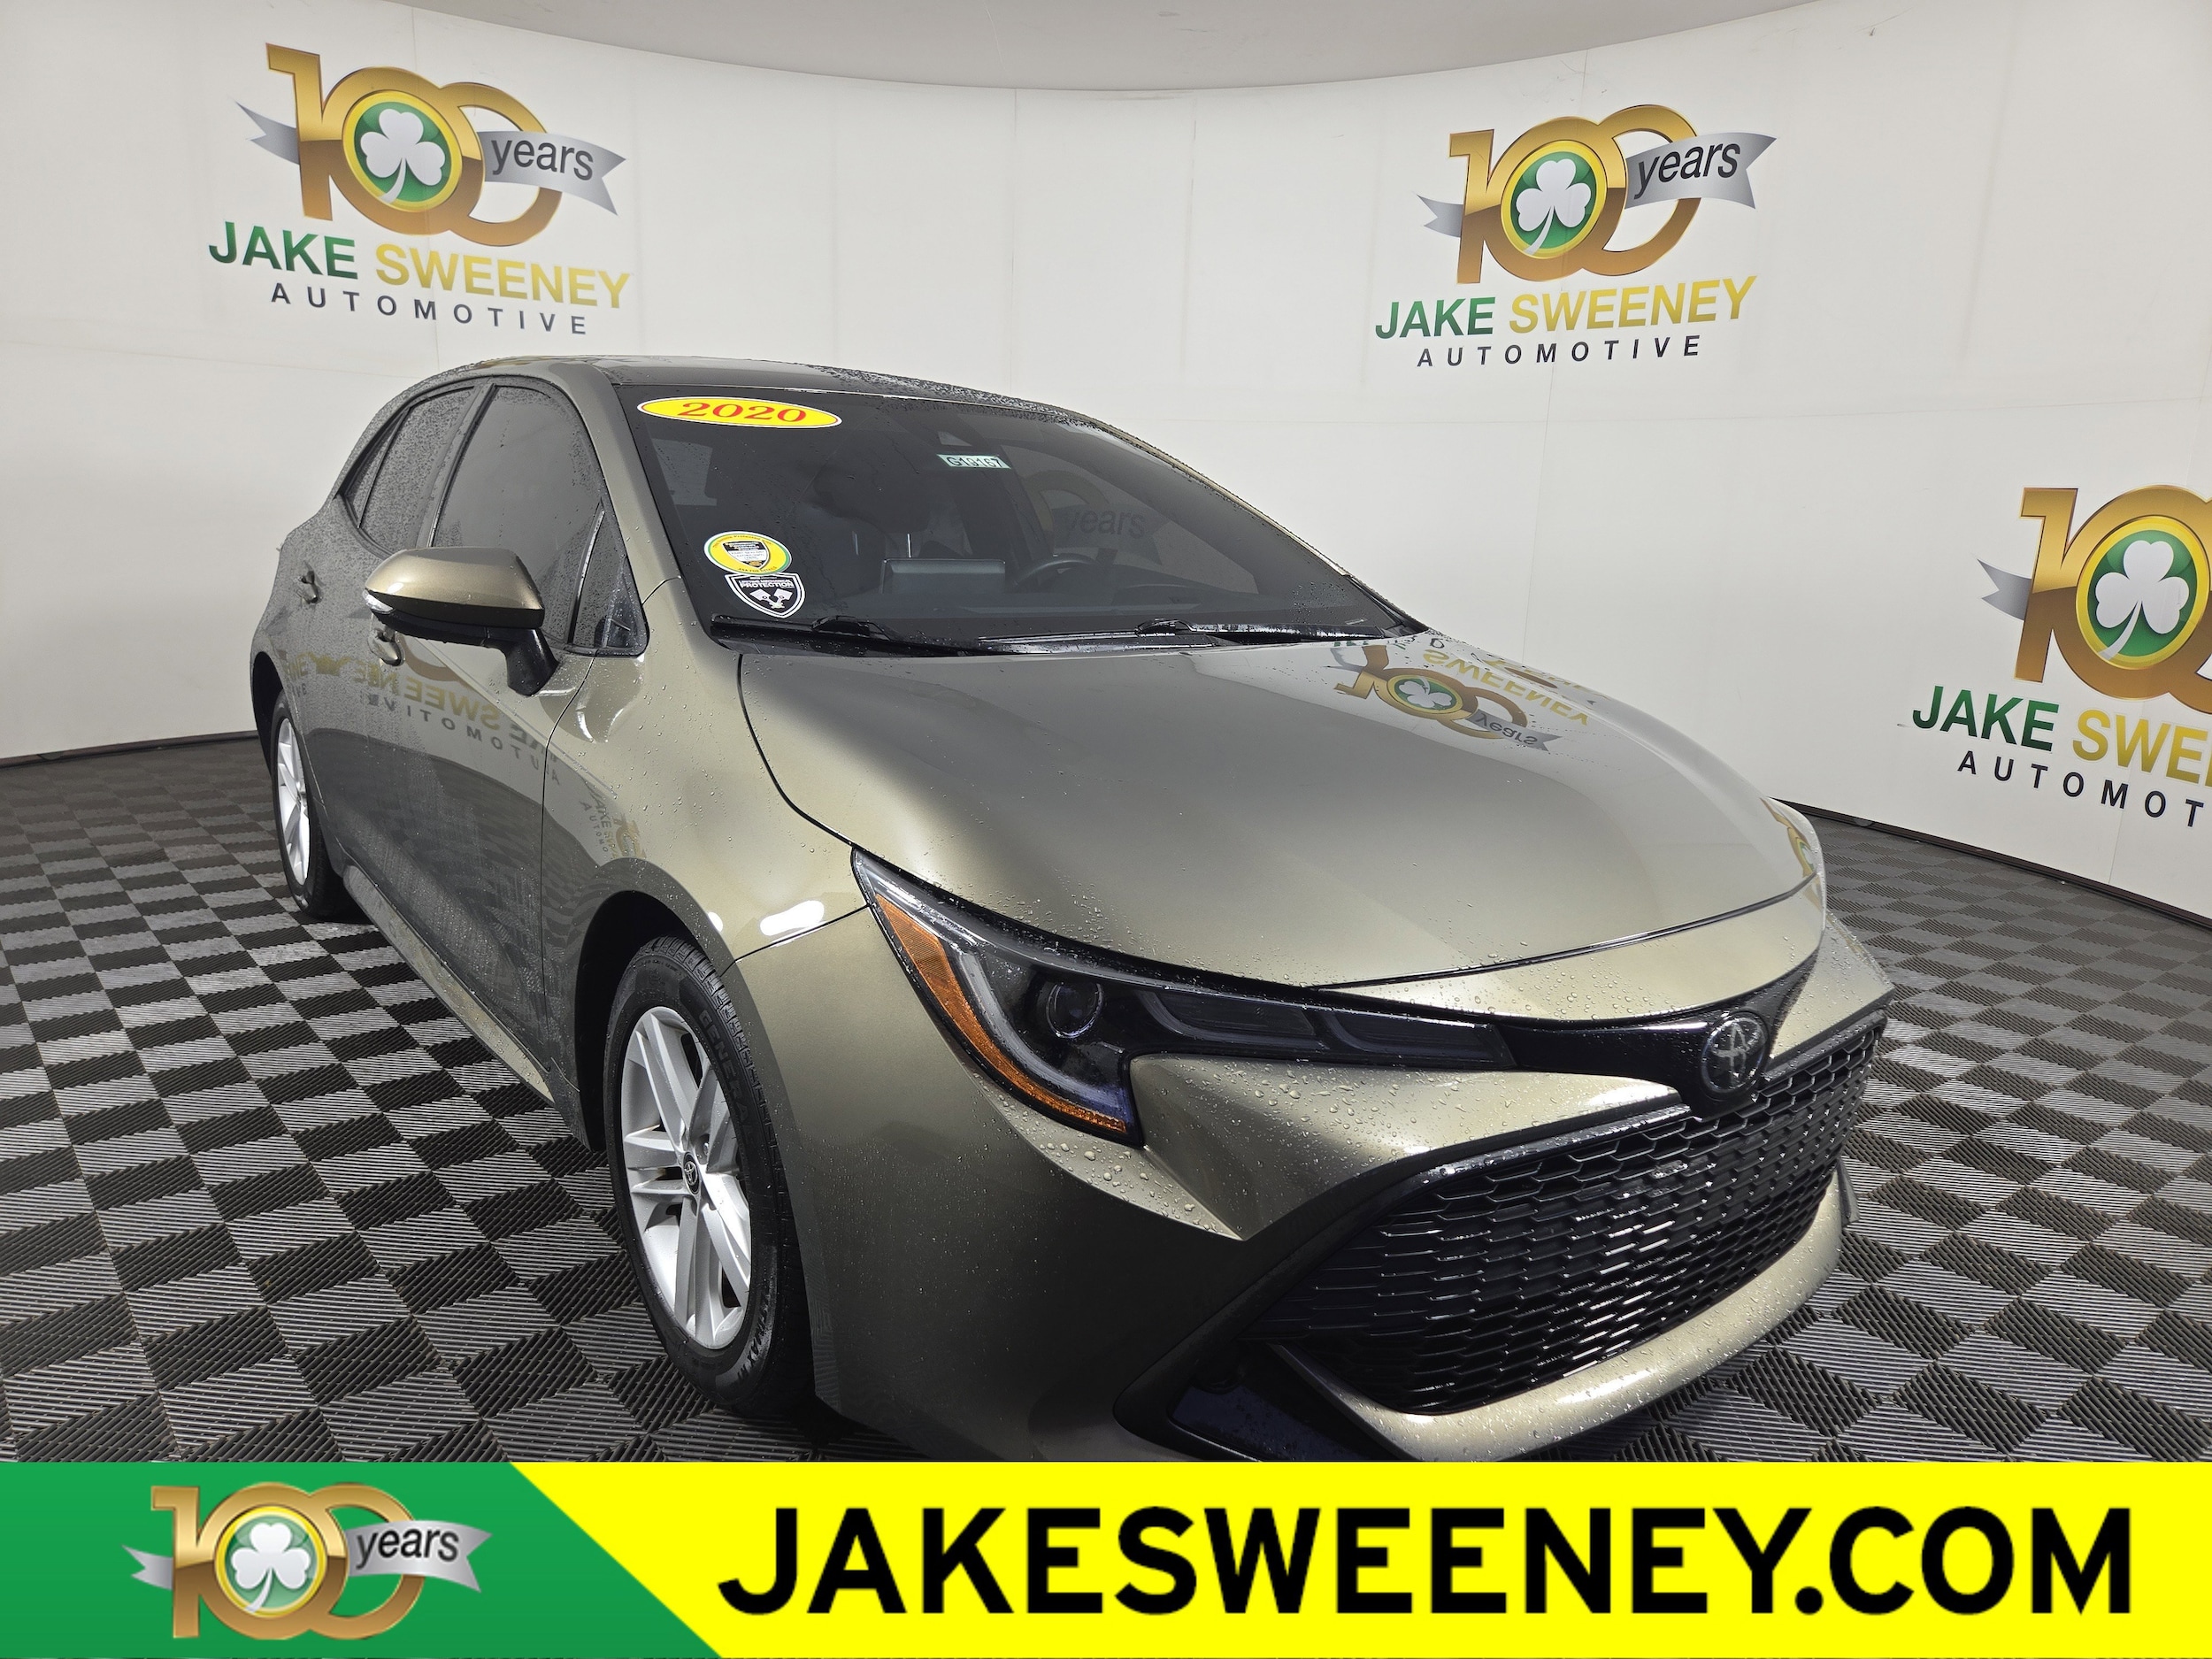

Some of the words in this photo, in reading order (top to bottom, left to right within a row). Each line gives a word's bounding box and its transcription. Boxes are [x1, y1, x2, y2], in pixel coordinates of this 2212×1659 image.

[265, 42, 563, 247] 100
[491, 137, 595, 181] years
[1448, 104, 1701, 286] 100
[1633, 142, 1742, 199] years
[208, 220, 359, 280] JAKE
[375, 243, 631, 309] SWEENEY
[271, 282, 588, 335] AUTOMOTIVE
[1375, 296, 1497, 340] JAKE
[1509, 275, 1758, 334] SWEENEY
[1417, 334, 1701, 368] AUTOMOTIVE
[681, 402, 807, 423] 2020
[946, 457, 1002, 468] G19167
[1912, 685, 2060, 753] JAKE
[2073, 709, 2212, 787] SWE
[1958, 750, 2205, 827] AUTOMOT
